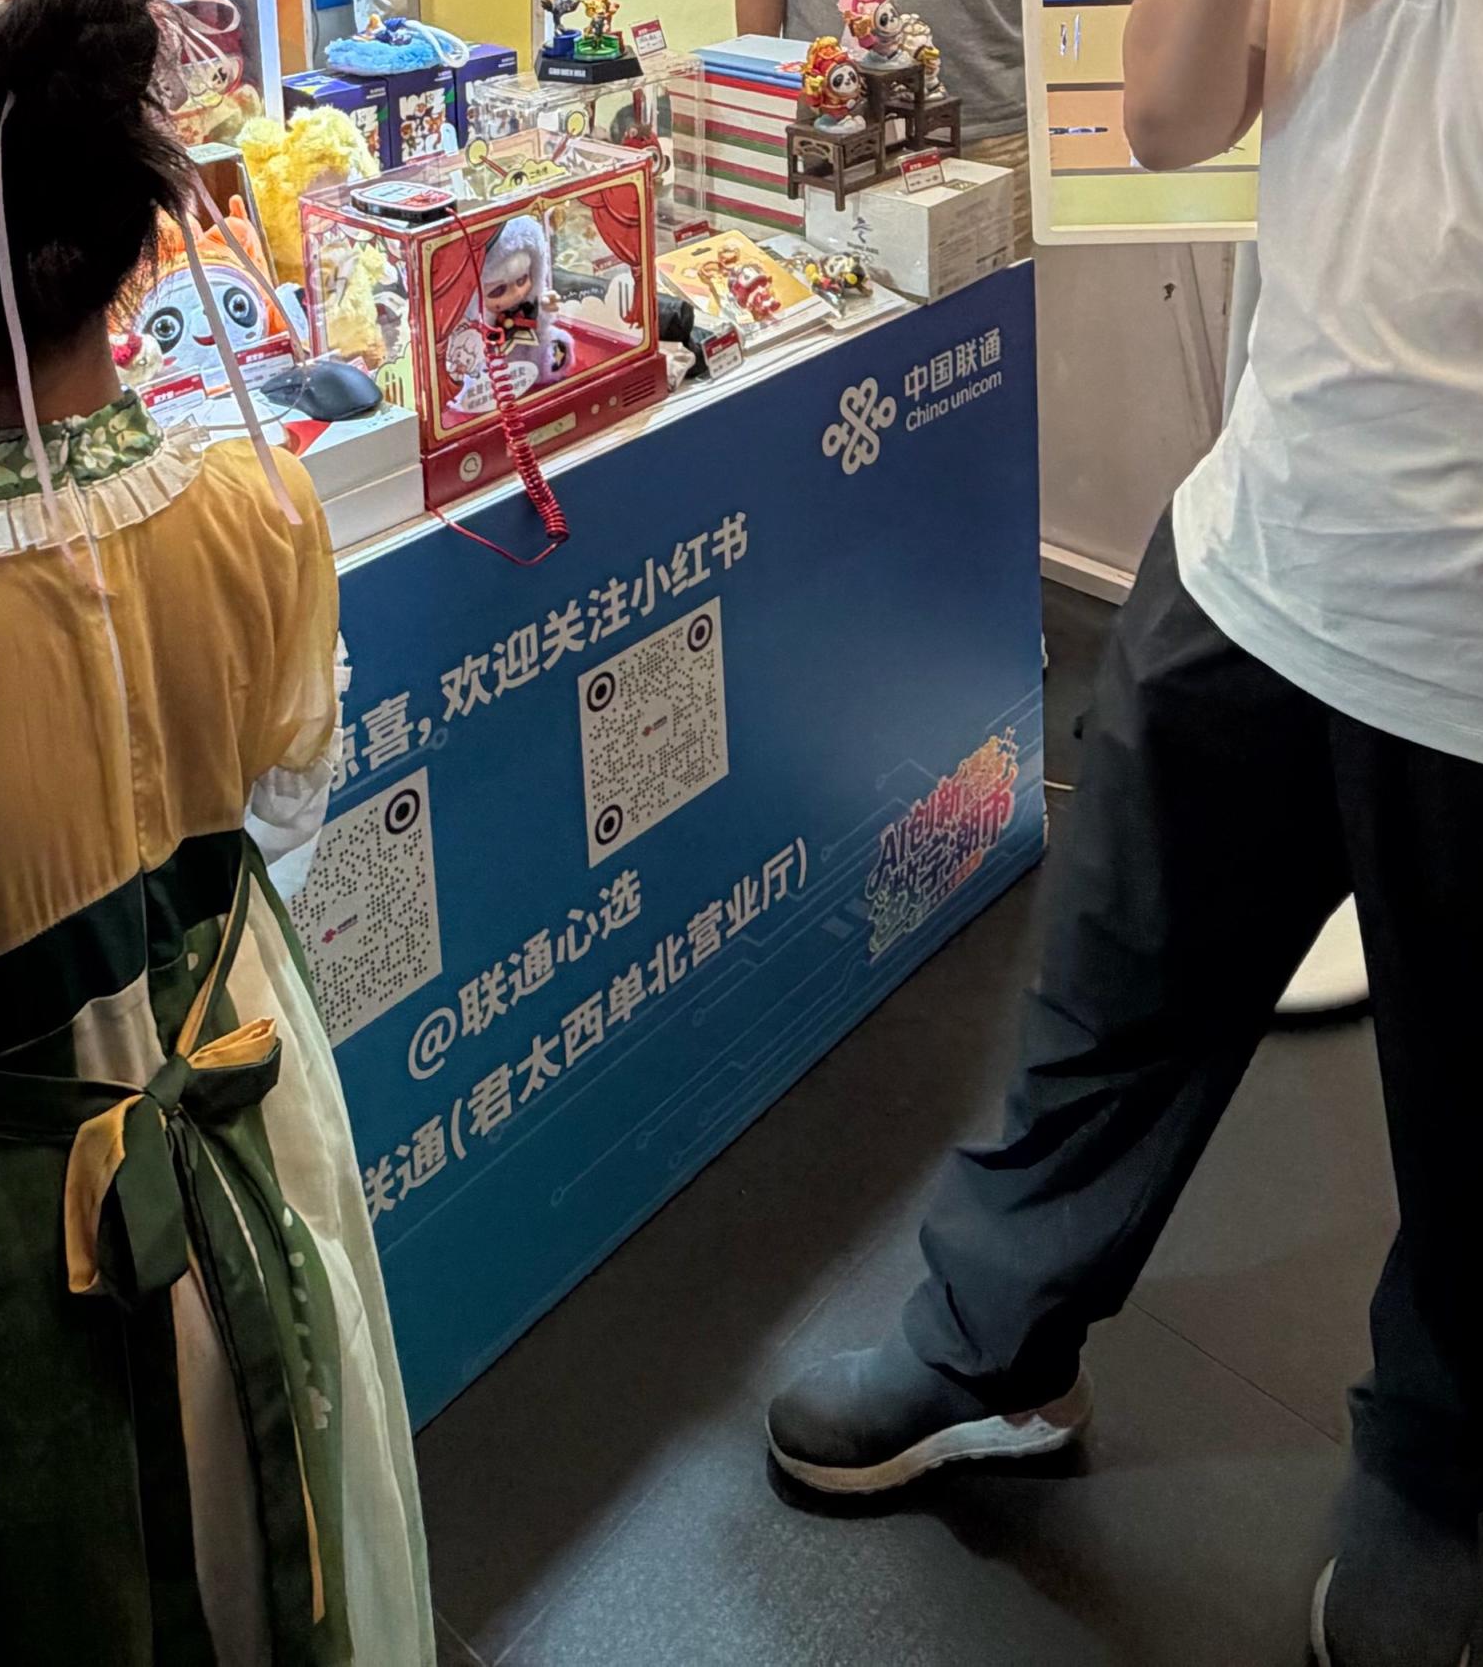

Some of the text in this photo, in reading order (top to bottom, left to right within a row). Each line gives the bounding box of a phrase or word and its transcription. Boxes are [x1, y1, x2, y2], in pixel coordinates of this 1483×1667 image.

[904, 327, 1002, 402] 中国联通
[905, 371, 1003, 432] China unicom
[408, 869, 642, 1081] @联通心选
